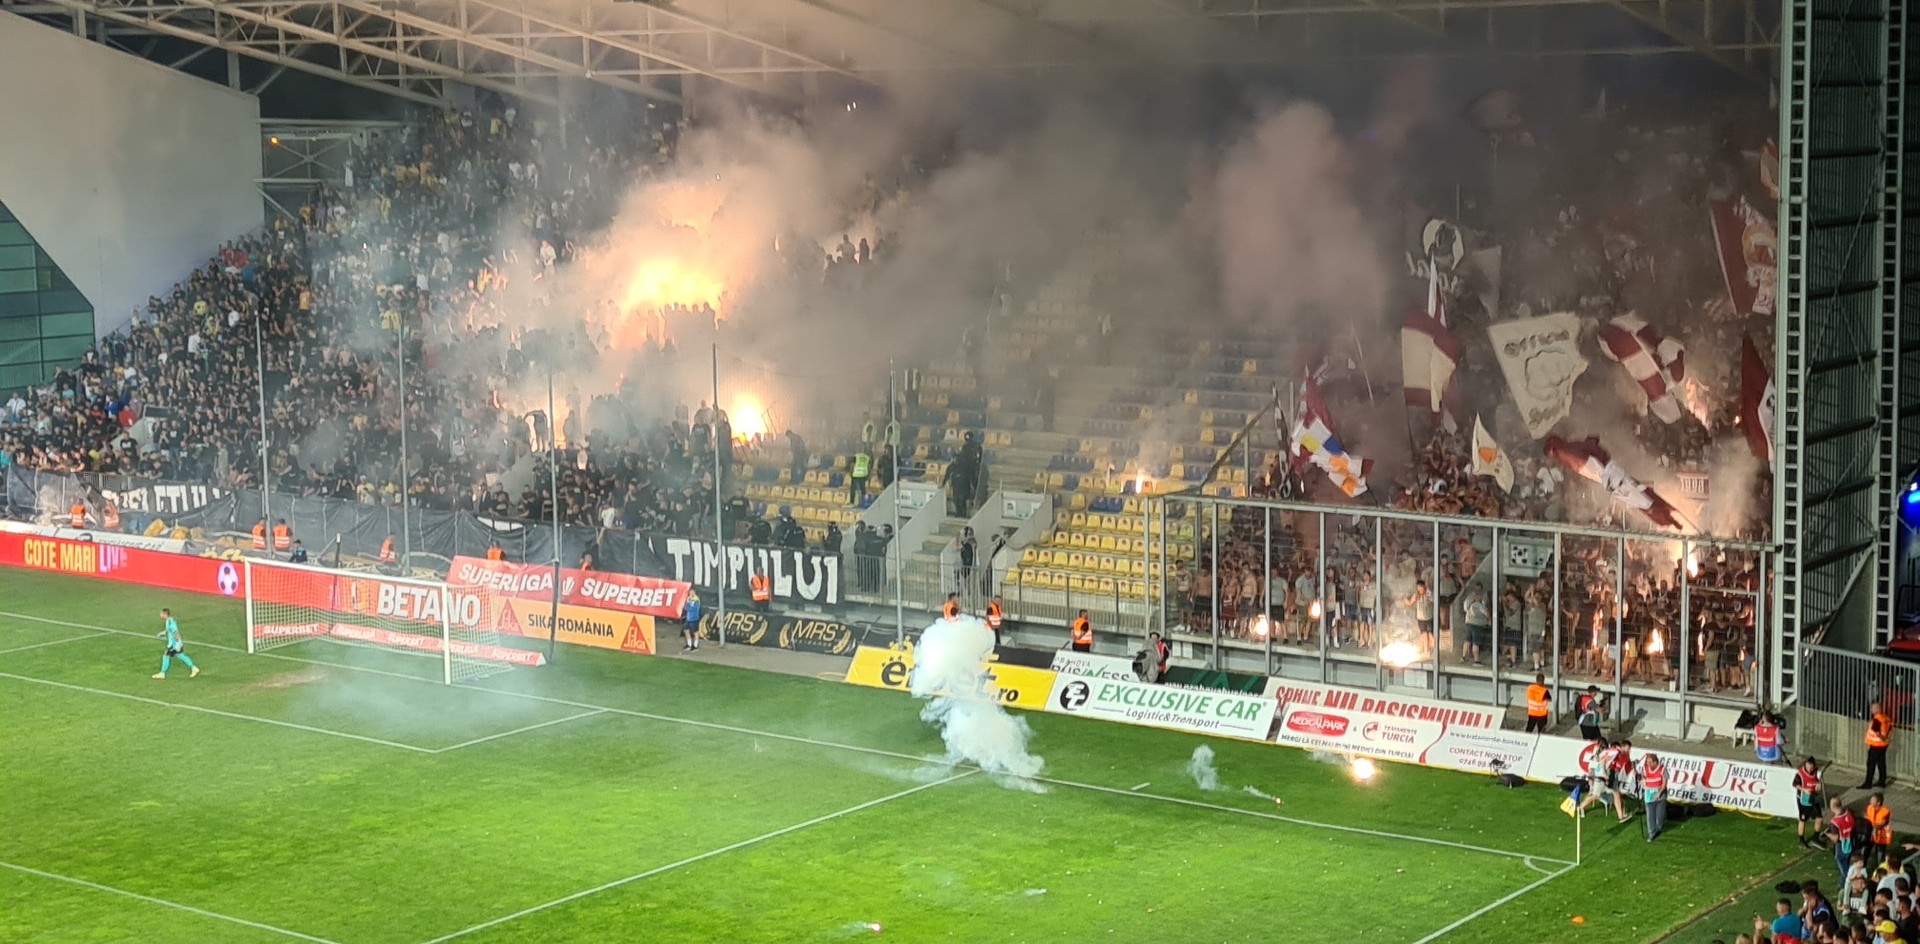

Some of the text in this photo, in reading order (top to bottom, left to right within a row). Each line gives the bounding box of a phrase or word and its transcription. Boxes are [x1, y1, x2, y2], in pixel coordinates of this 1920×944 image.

[24, 539, 57, 568] COTE
[60, 543, 96, 572] MARI
[666, 538, 838, 604] TIMPULUI
[458, 564, 677, 607] SUPERLIGA SUPERBET
[377, 582, 480, 627] BETANO
[528, 613, 615, 638] SIKA ROMÂNIA
[624, 623, 648, 650] Sika
[793, 620, 839, 641] MRS
[1097, 684, 1261, 721] EXCLUSIVE CAR
[1126, 707, 1220, 729] Logistic&Transport
[1382, 732, 1415, 744] TURCIA
[1449, 747, 1523, 763] CONTACT NON STOP
[1660, 756, 1702, 773] CENTRUL
[1731, 766, 1768, 781] MEDICAL
